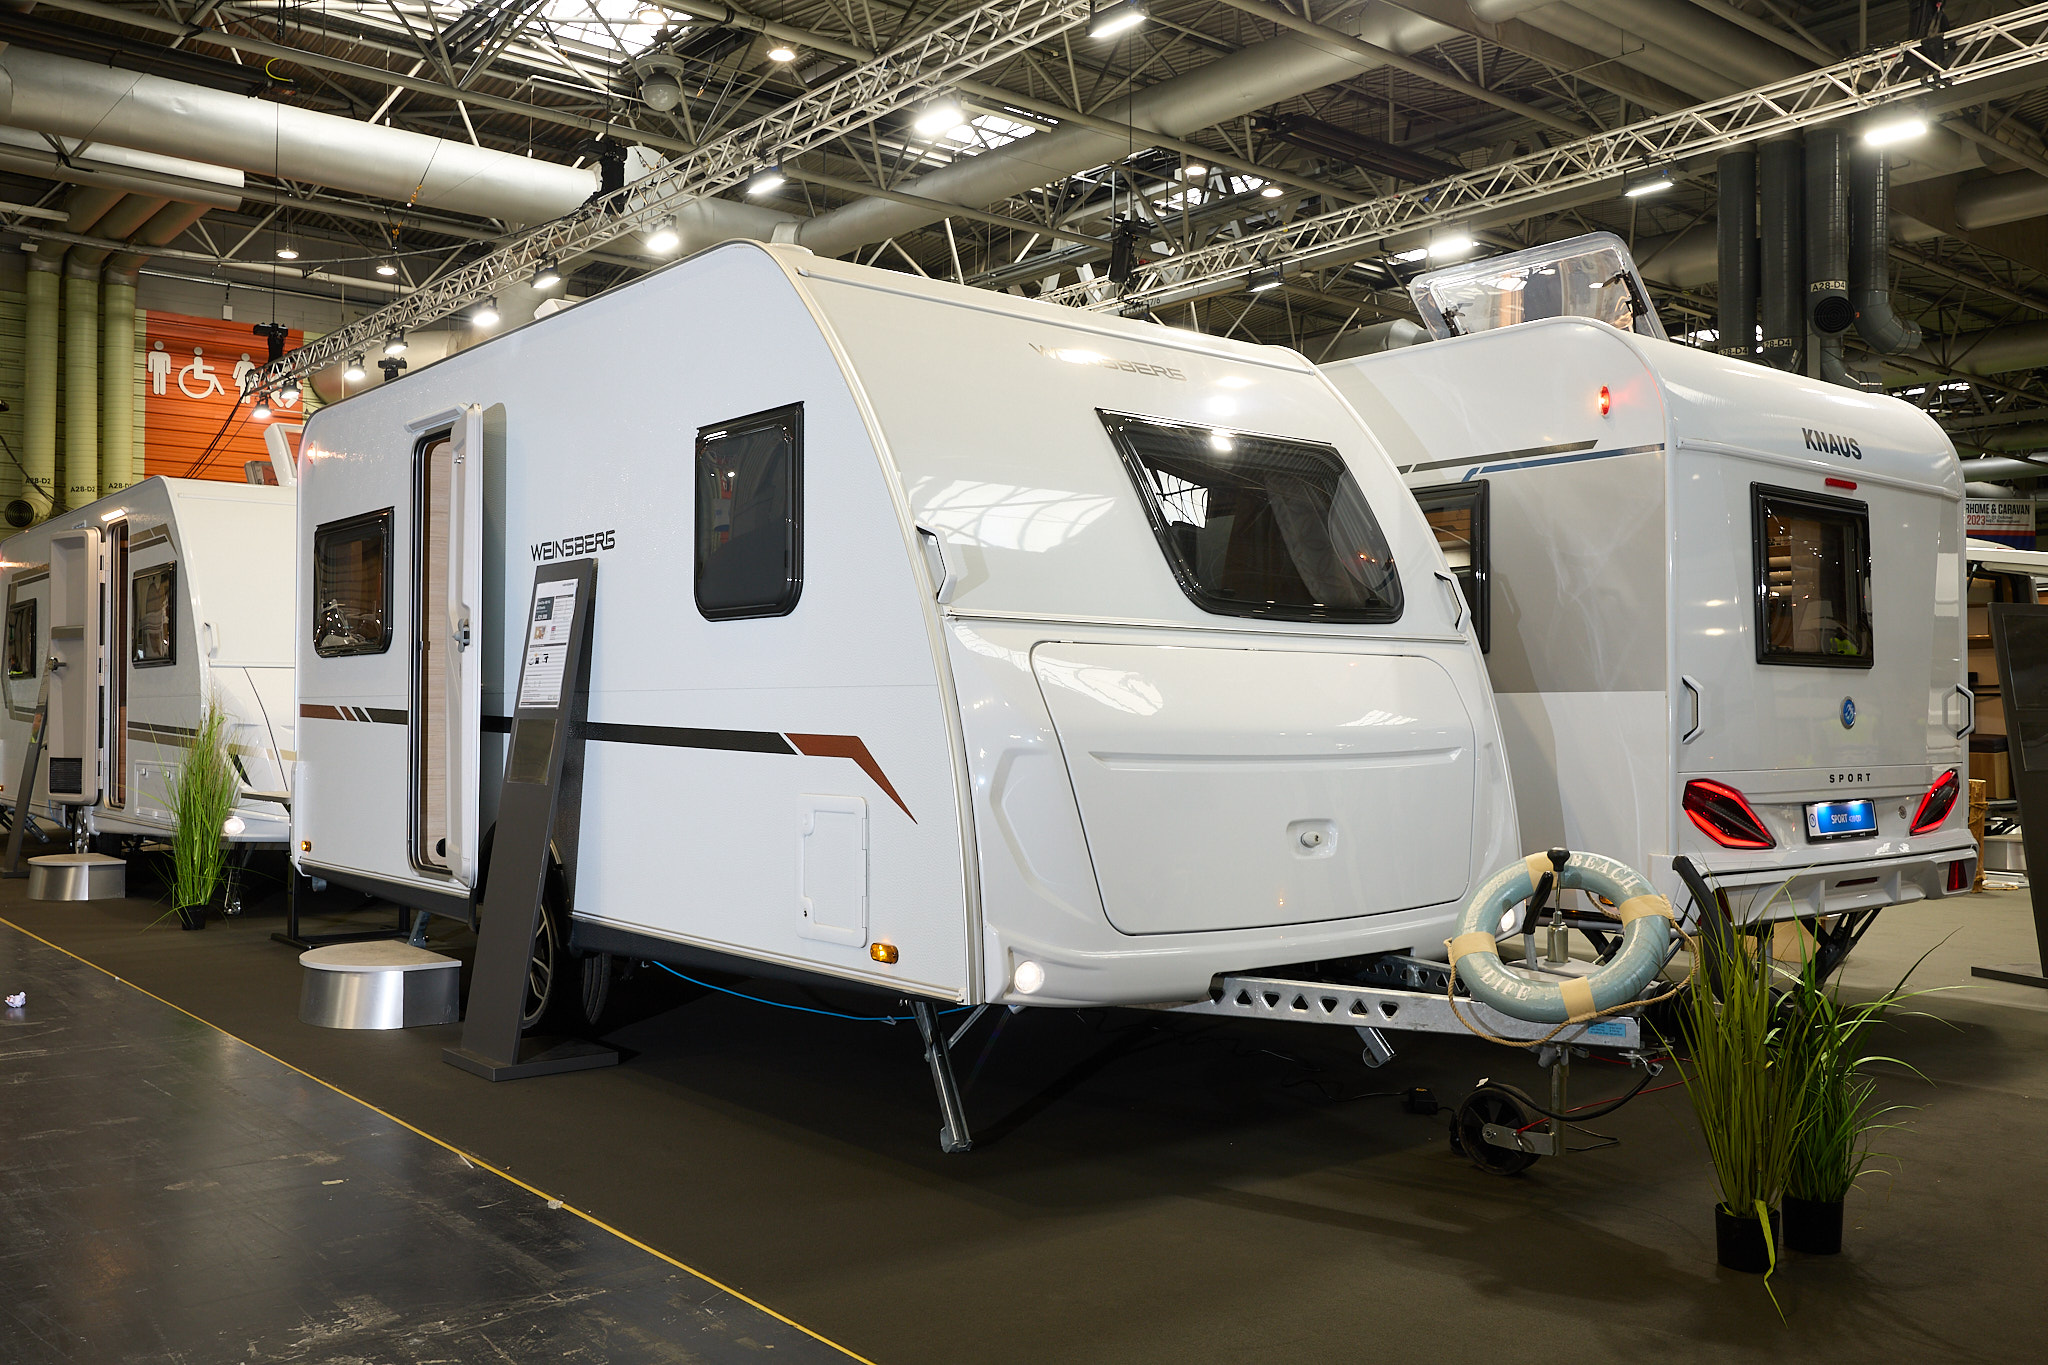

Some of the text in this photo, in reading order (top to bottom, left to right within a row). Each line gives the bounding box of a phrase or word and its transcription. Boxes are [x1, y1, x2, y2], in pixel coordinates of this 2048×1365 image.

[1812, 281, 1846, 292] A28-D4
[1764, 339, 1791, 349] 28-D4
[1720, 346, 1748, 356] 28-D4
[1801, 427, 1862, 460] KNAUS
[1991, 503, 1996, 515] &
[1998, 504, 2030, 515] CARAVAN
[1967, 515, 1986, 526] 2023
[530, 529, 616, 562] WEINSBERG
[1829, 773, 1871, 783] SPORT
[1831, 814, 1848, 824] SPORT
[1567, 852, 1642, 890] BEACH
[1479, 970, 1532, 1002] LIFE
